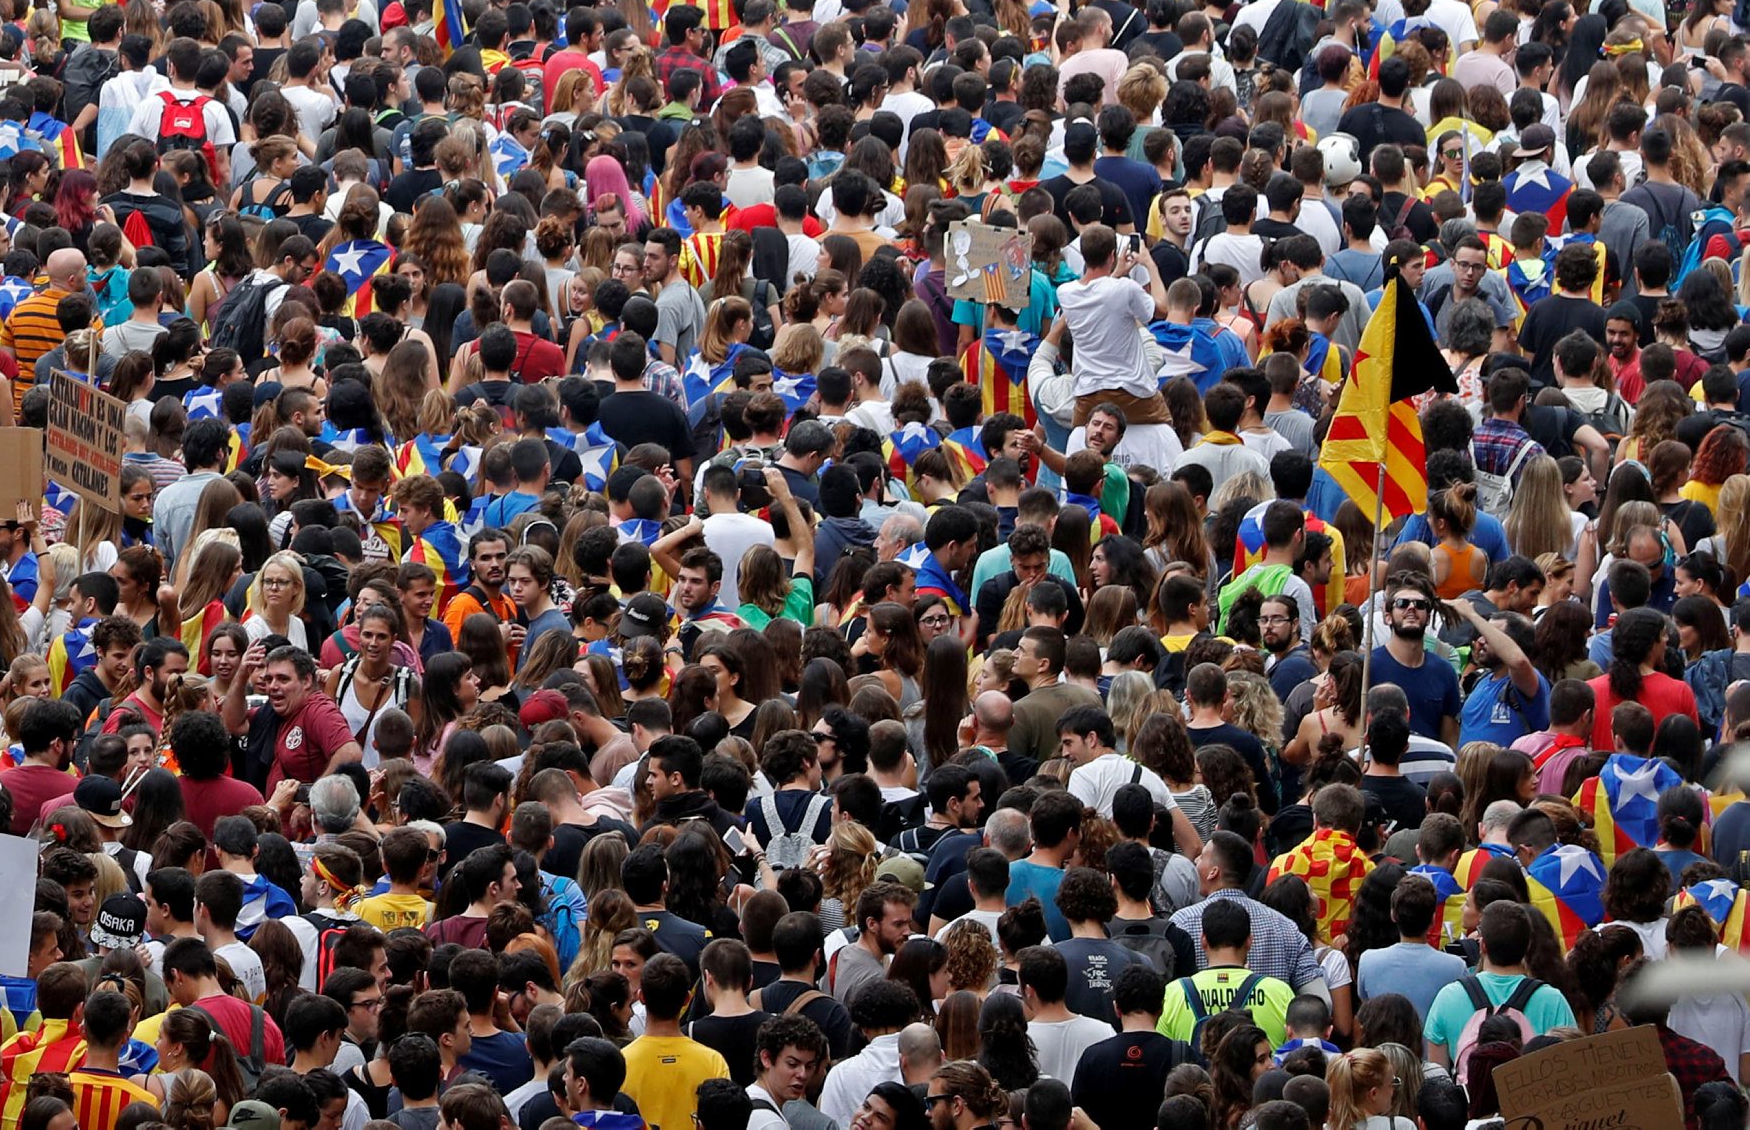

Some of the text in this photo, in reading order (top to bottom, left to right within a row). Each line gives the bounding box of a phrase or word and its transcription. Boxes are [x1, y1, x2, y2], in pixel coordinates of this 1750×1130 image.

[49, 398, 68, 430] GRAN
[97, 424, 103, 448] Y
[105, 428, 117, 456] LOS
[96, 397, 105, 422] ES
[108, 402, 124, 433] UNA
[47, 453, 52, 470] Y
[52, 456, 68, 477] MUCHO
[100, 910, 135, 933] OSAKA
[1504, 1038, 1653, 1094] ELLOS TIENEN
